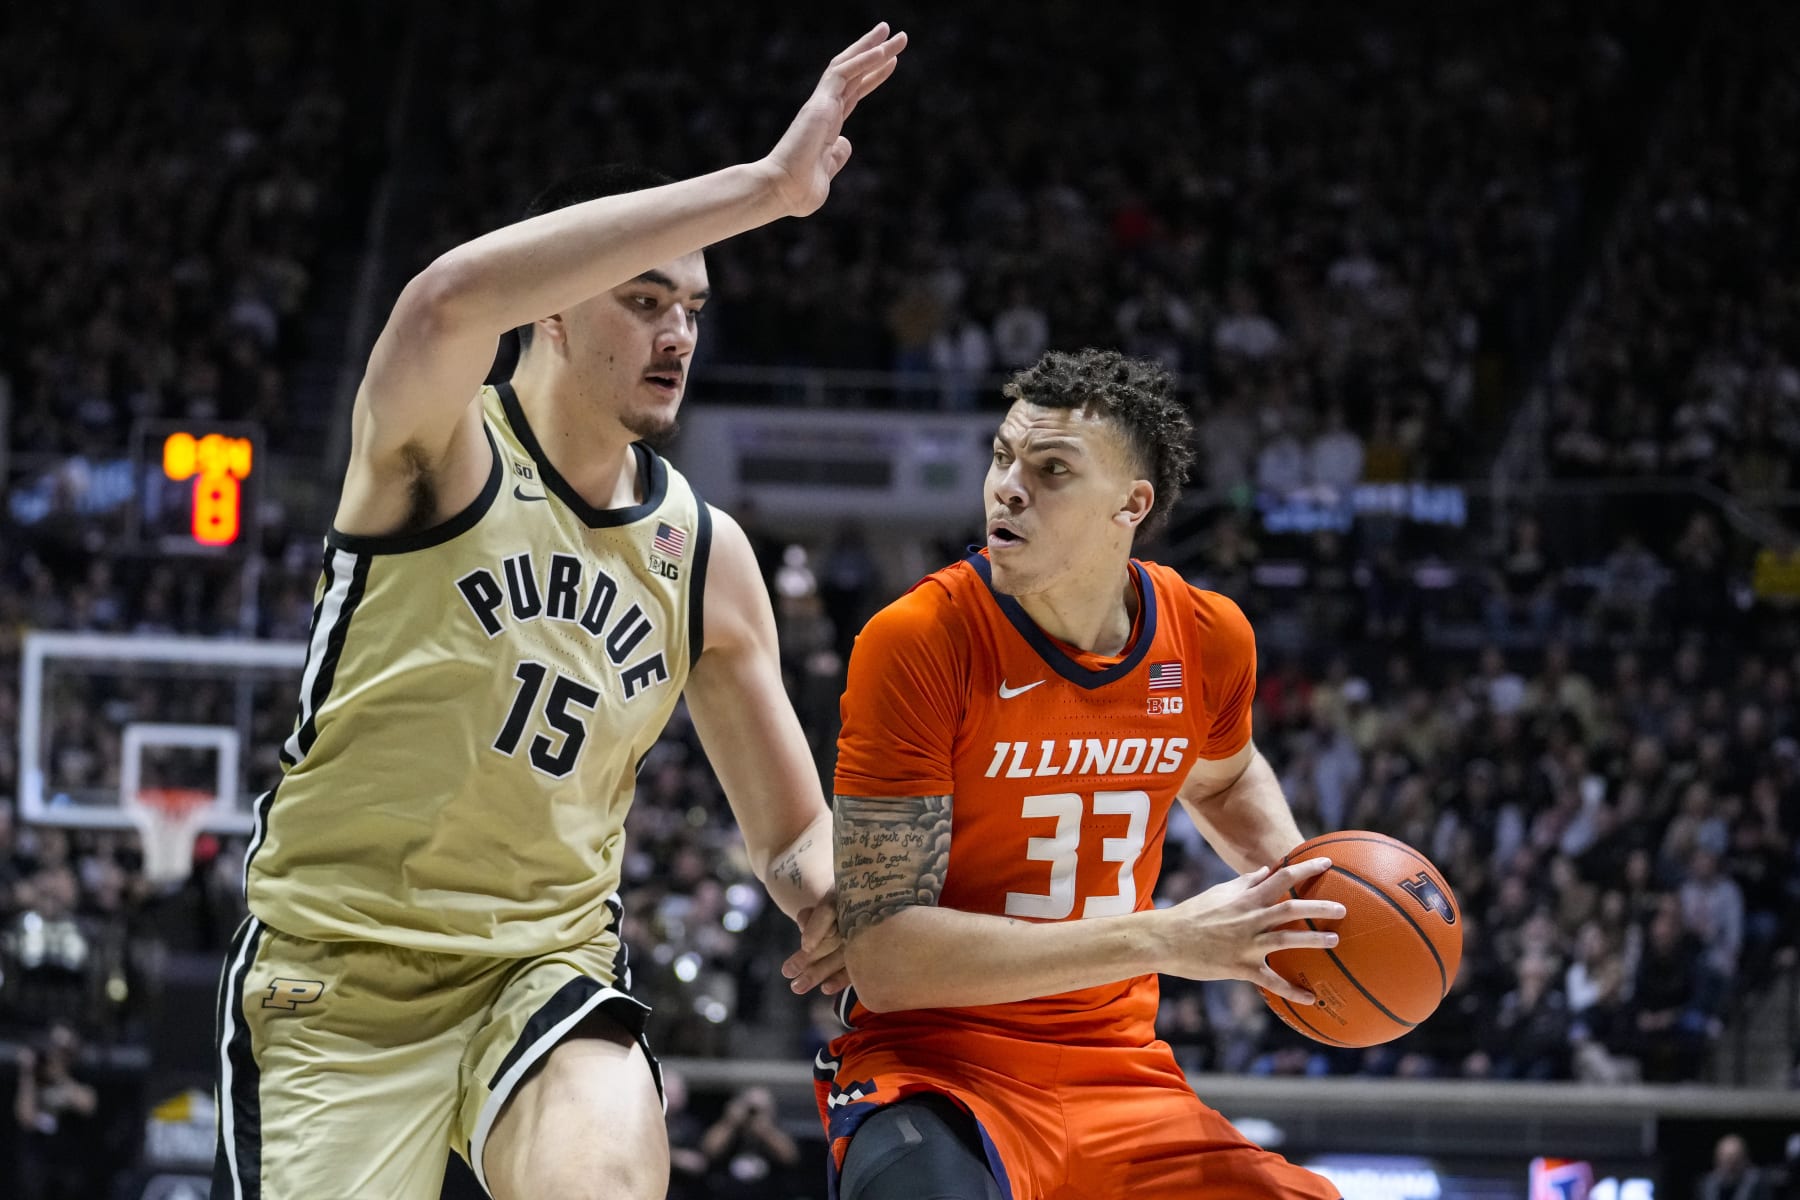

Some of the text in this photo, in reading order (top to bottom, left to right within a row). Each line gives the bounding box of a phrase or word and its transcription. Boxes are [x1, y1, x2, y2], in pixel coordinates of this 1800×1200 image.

[455, 552, 670, 703] PURDUE
[492, 659, 600, 780] 15
[984, 737, 1189, 779] ILLINOIS
[1004, 790, 1150, 920] 33
[261, 977, 325, 1011] P
